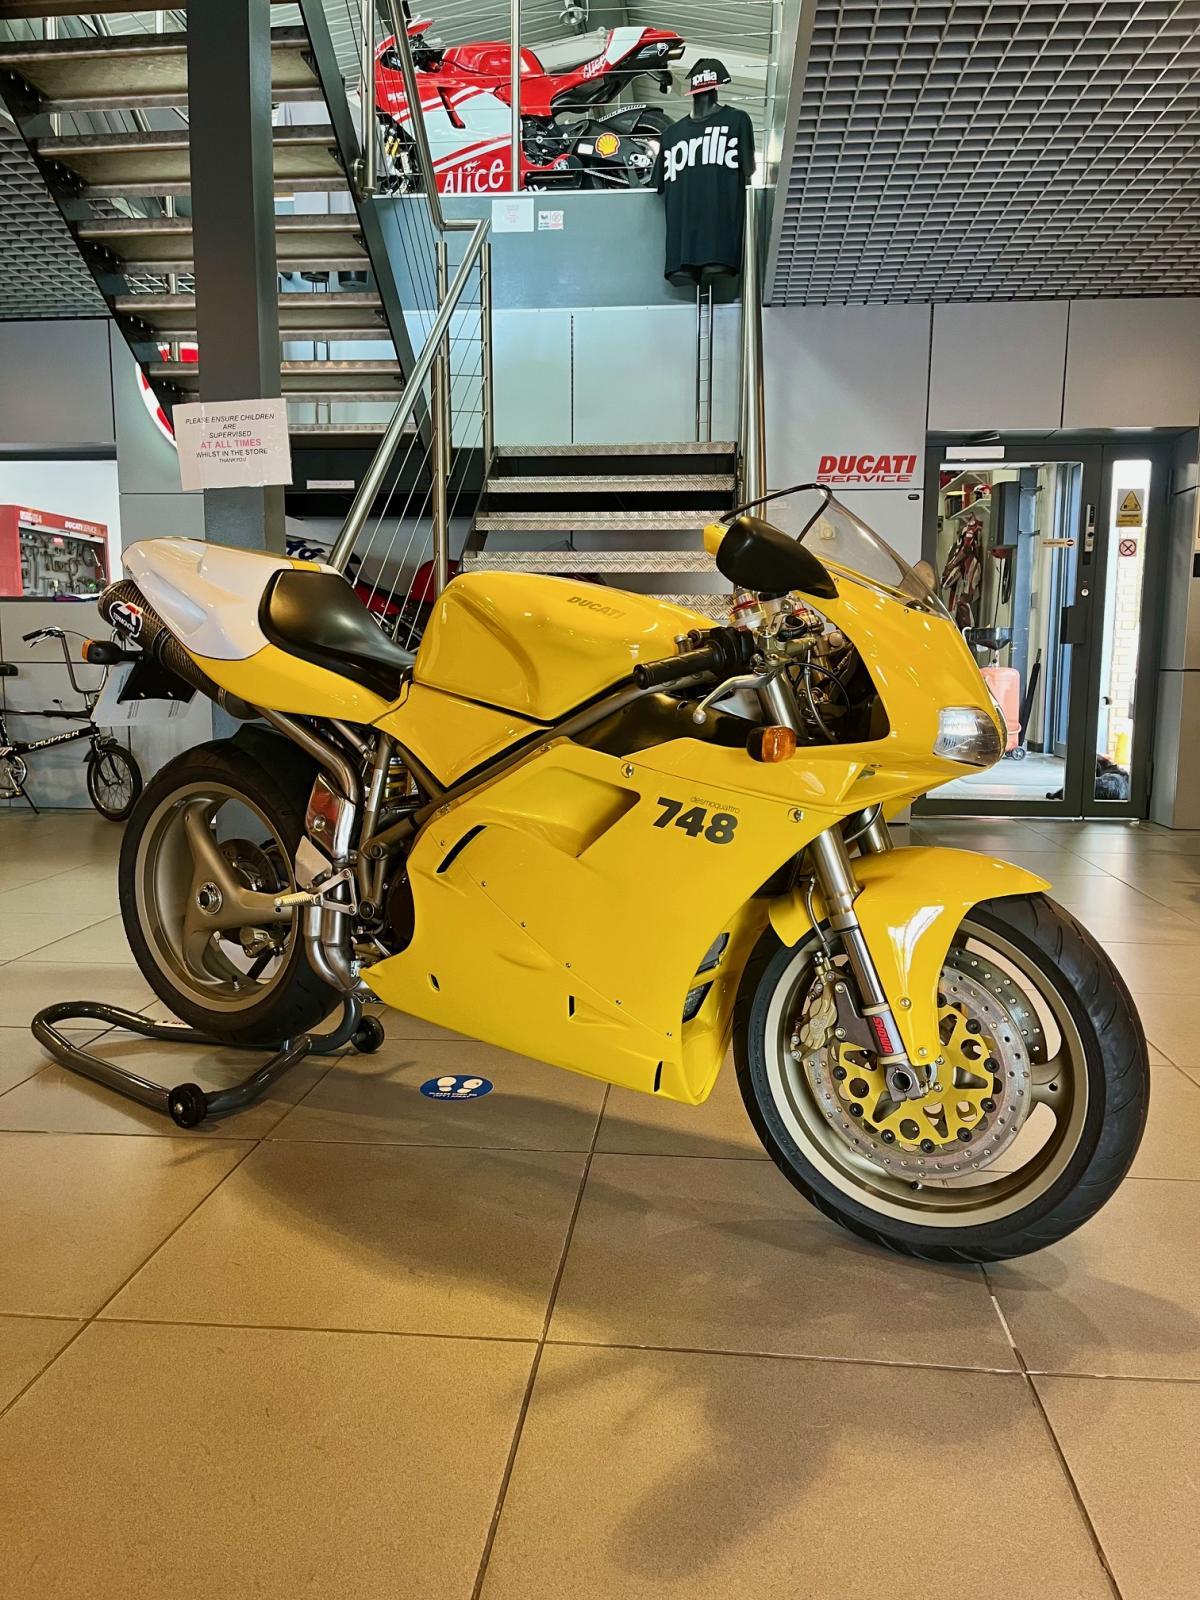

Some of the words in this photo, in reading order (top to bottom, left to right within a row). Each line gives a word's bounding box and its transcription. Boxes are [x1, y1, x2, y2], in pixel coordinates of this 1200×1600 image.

[443, 158, 505, 193] Alice
[211, 415, 239, 423] ENSURE
[240, 413, 275, 421] CHILDREN
[209, 430, 252, 439] SUPERVISED
[200, 441, 212, 449] AT
[214, 440, 232, 449] ALL
[235, 438, 262, 447] TIMES
[196, 450, 220, 458] WHILST
[817, 455, 917, 475] DUCATI
[816, 474, 913, 483] SERVICE
[690, 796, 741, 815] desmoquattro
[652, 796, 739, 845] 748
